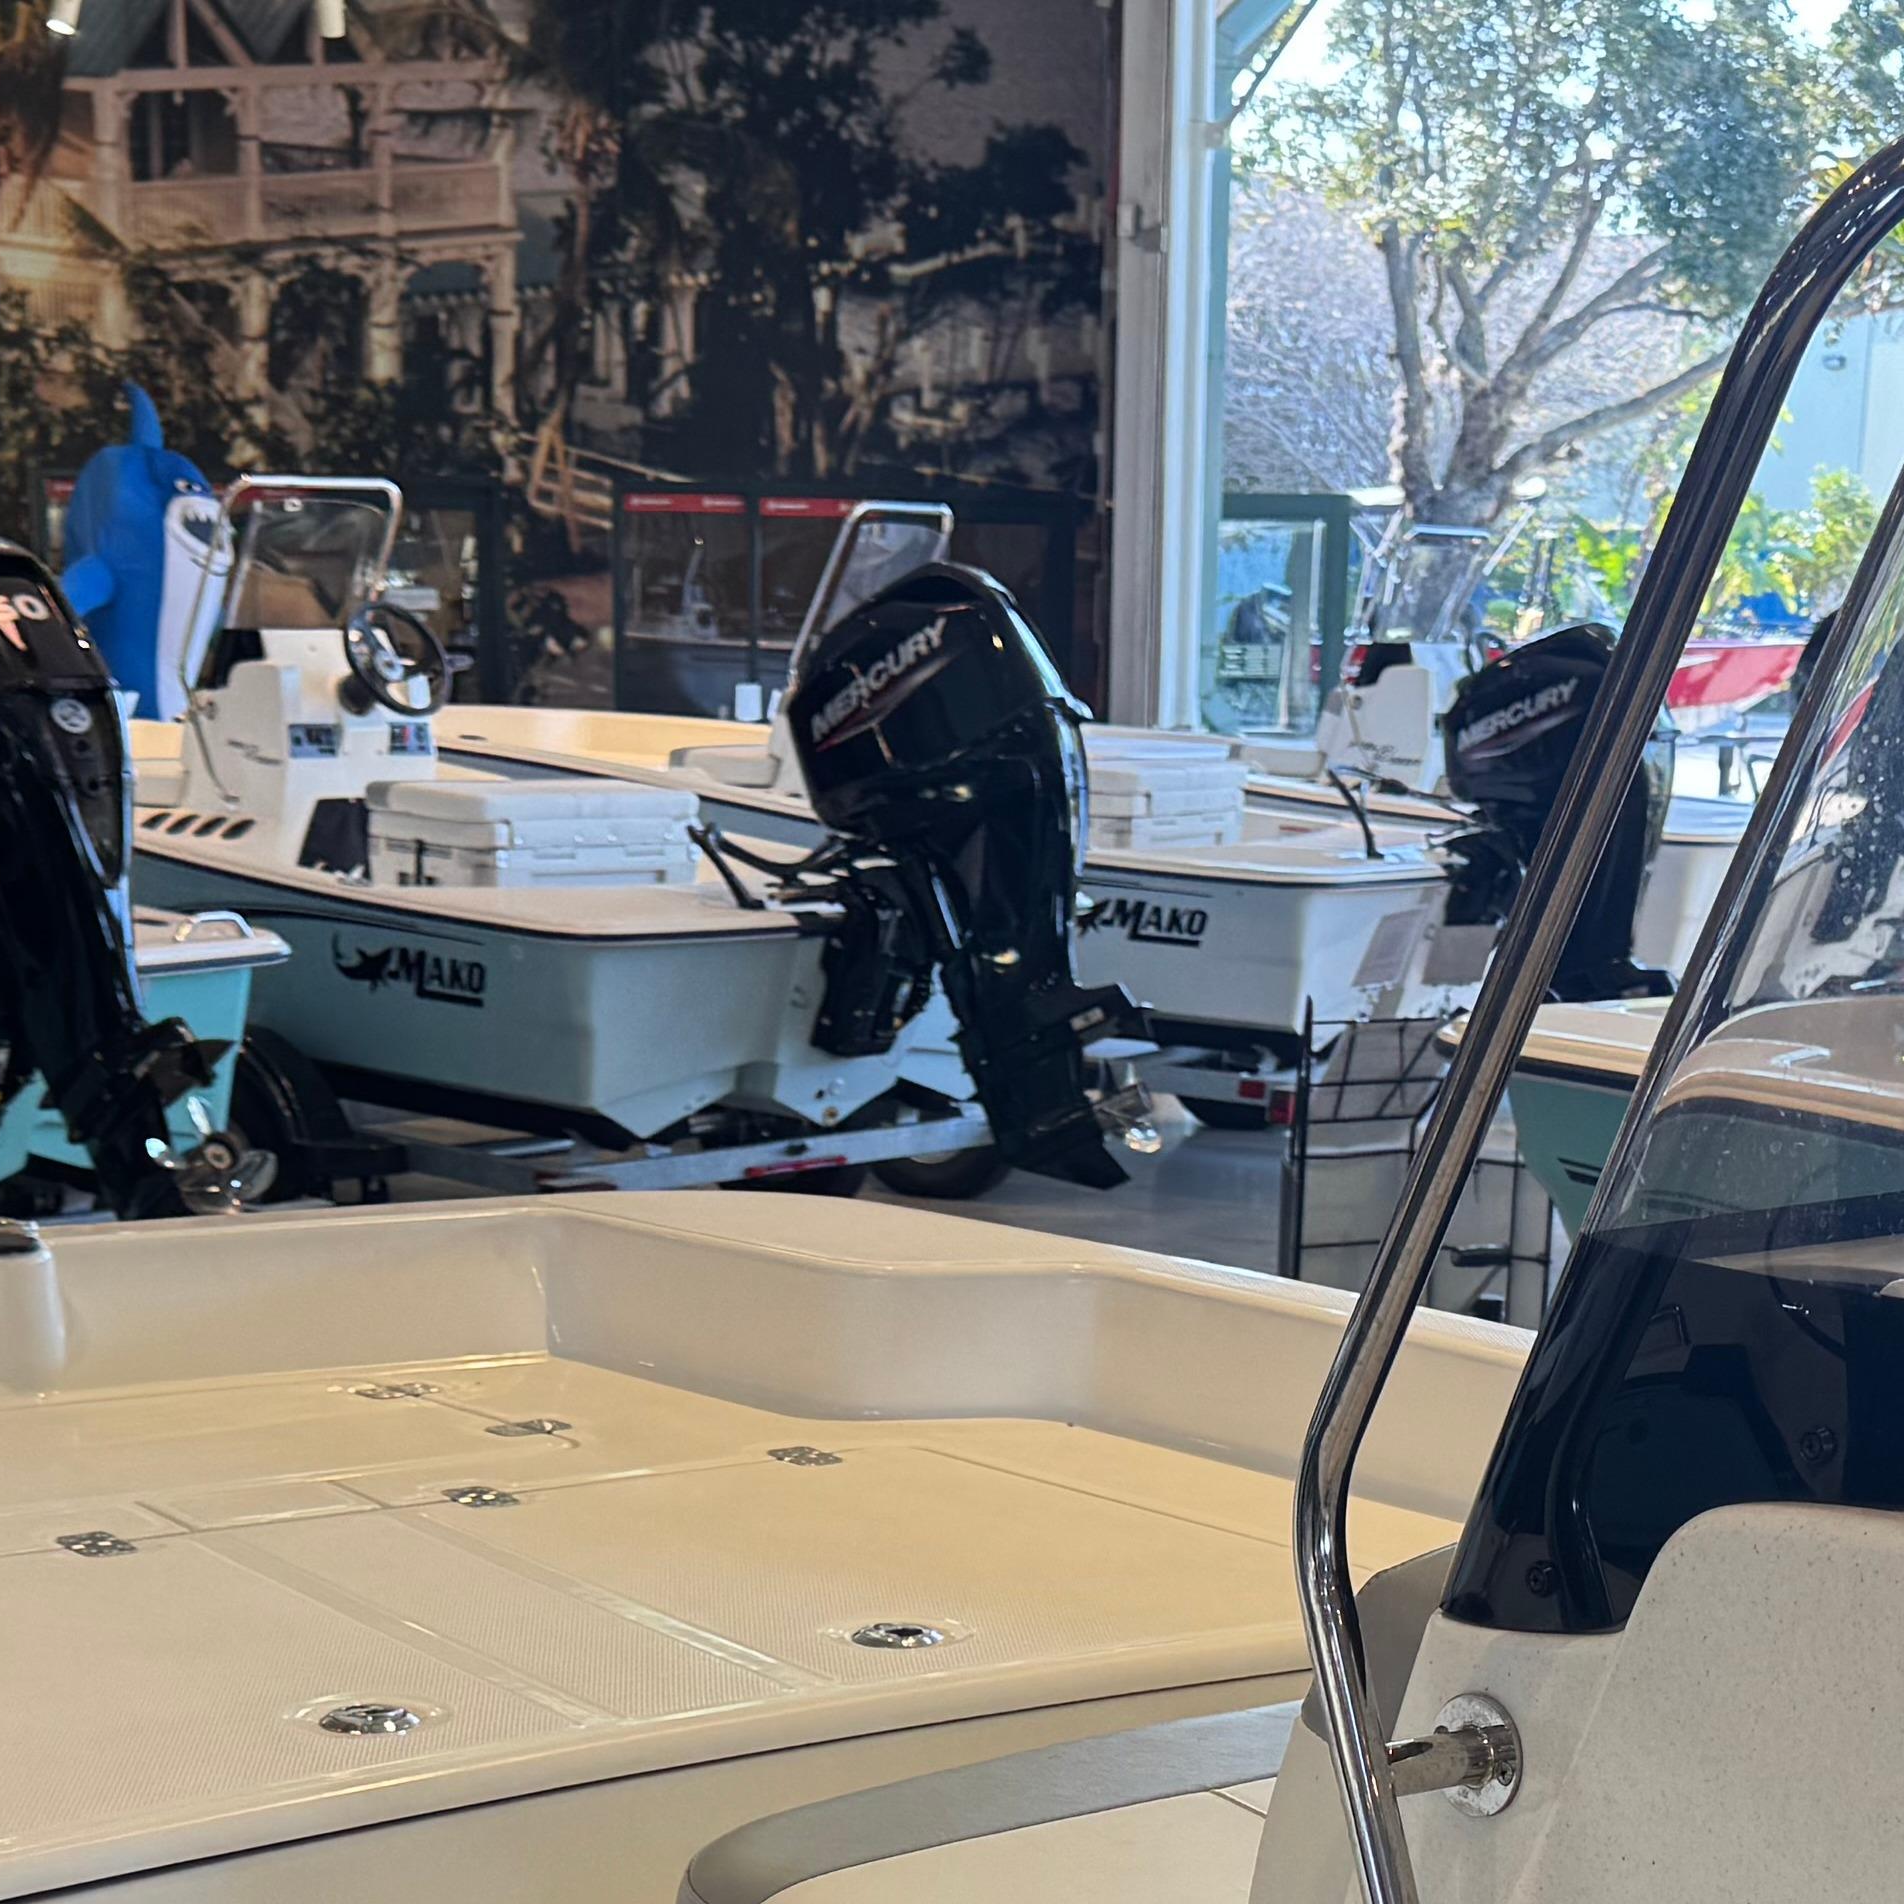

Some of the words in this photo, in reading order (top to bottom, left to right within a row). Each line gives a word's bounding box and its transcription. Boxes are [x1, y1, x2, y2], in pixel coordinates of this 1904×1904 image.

[811, 616, 946, 743] MERCURY
[1457, 677, 1579, 751] MERCURY
[1113, 898, 1210, 948] MAKO
[396, 946, 487, 1008] MAKO
